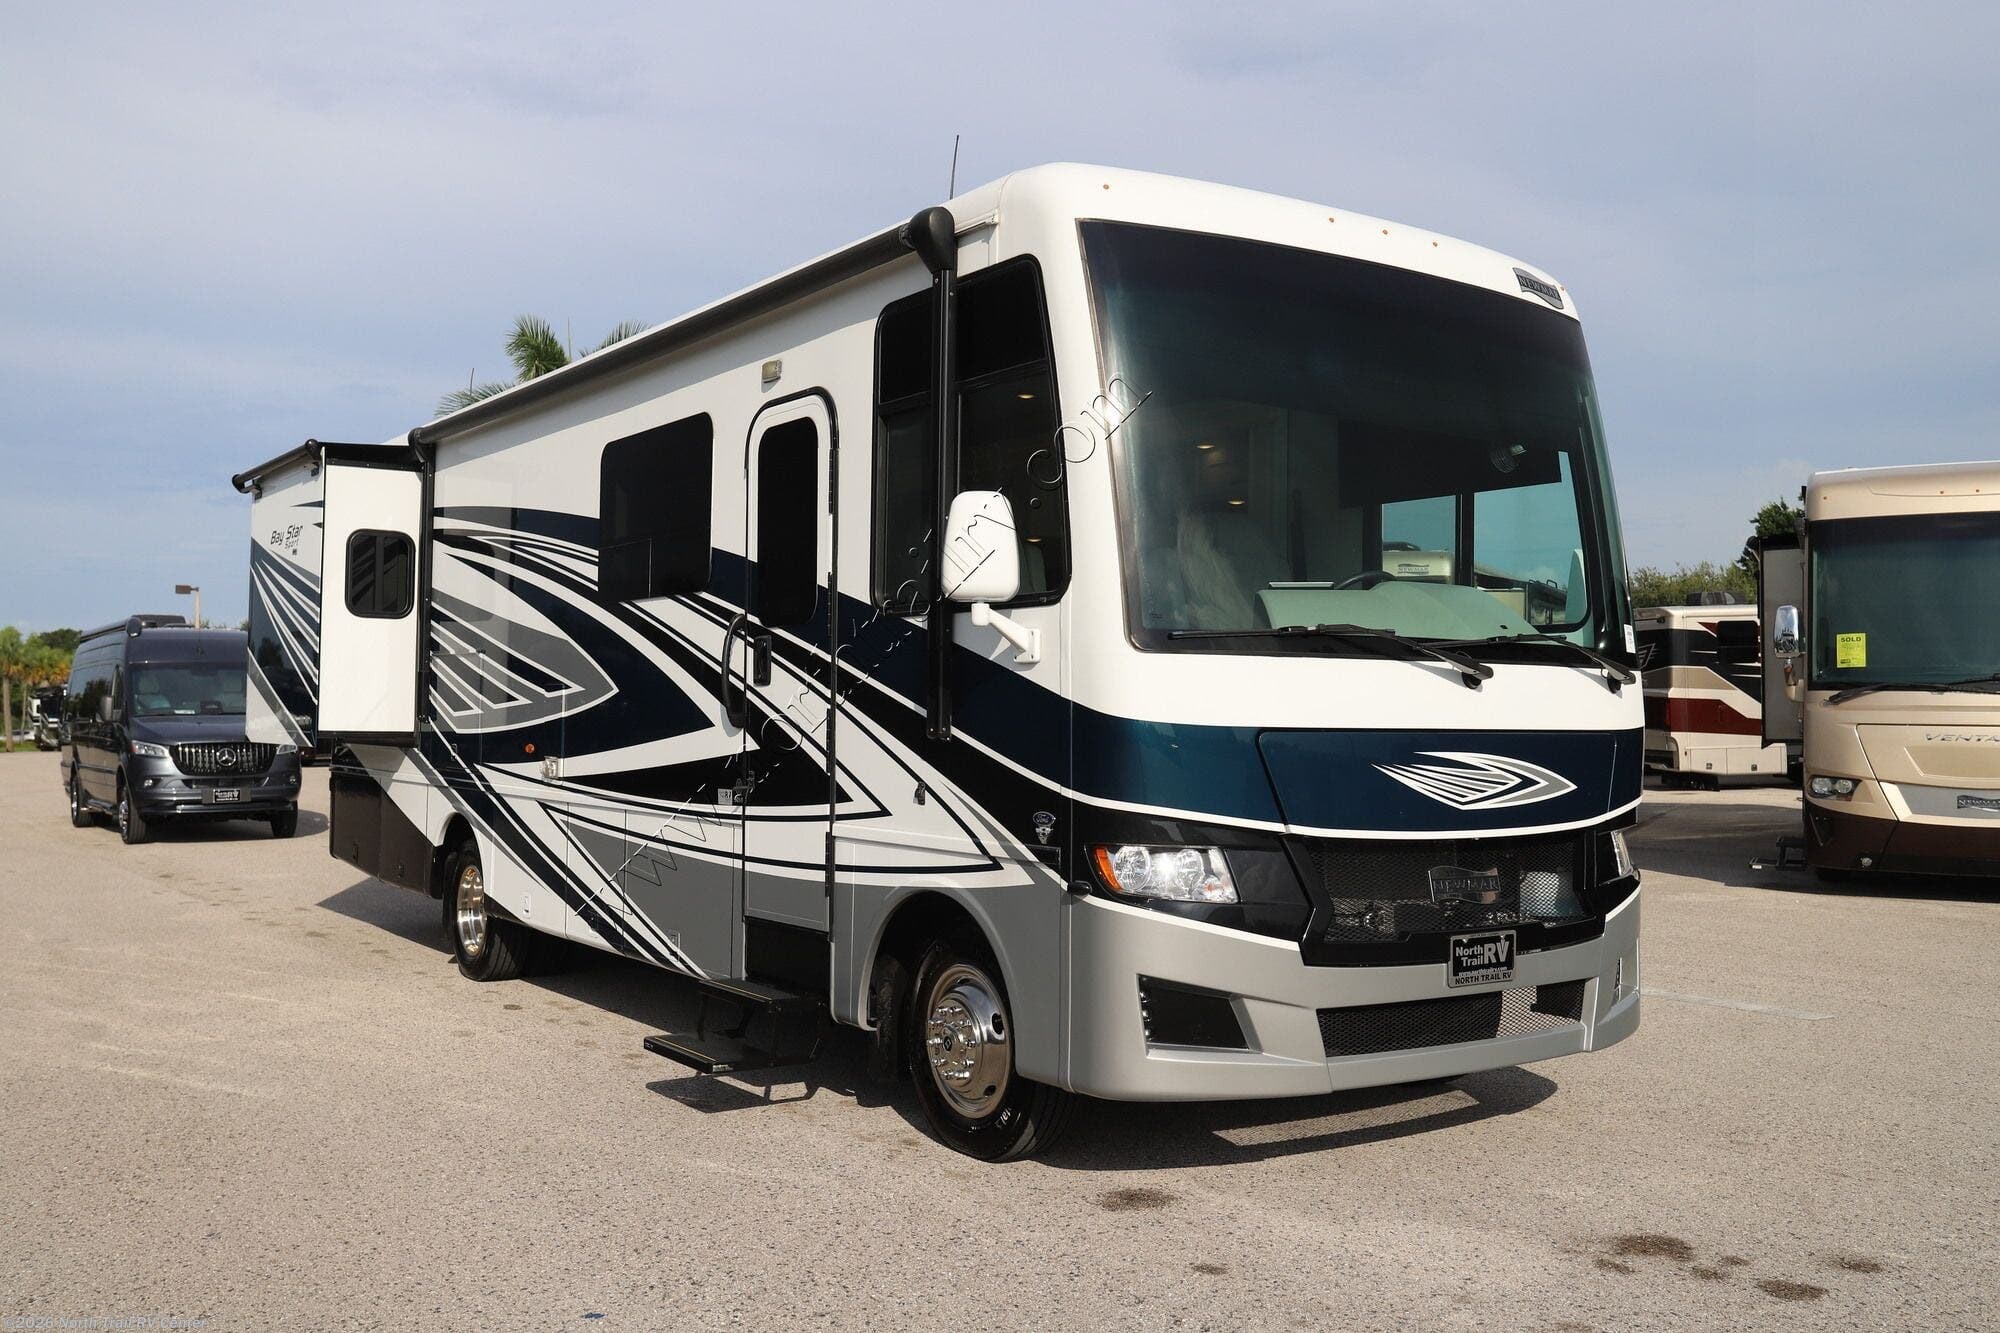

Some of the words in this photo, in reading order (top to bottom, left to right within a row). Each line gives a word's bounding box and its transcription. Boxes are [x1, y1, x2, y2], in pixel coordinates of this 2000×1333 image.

[270, 530, 284, 546] Bay
[285, 524, 303, 539] Star
[1455, 945, 1483, 957] North
[1484, 941, 1510, 964] RV
[1461, 955, 1483, 967] Trail
[1455, 976, 1479, 985] NORTH
[1481, 972, 1501, 982] TRAIL
[1503, 971, 1512, 979] RV
